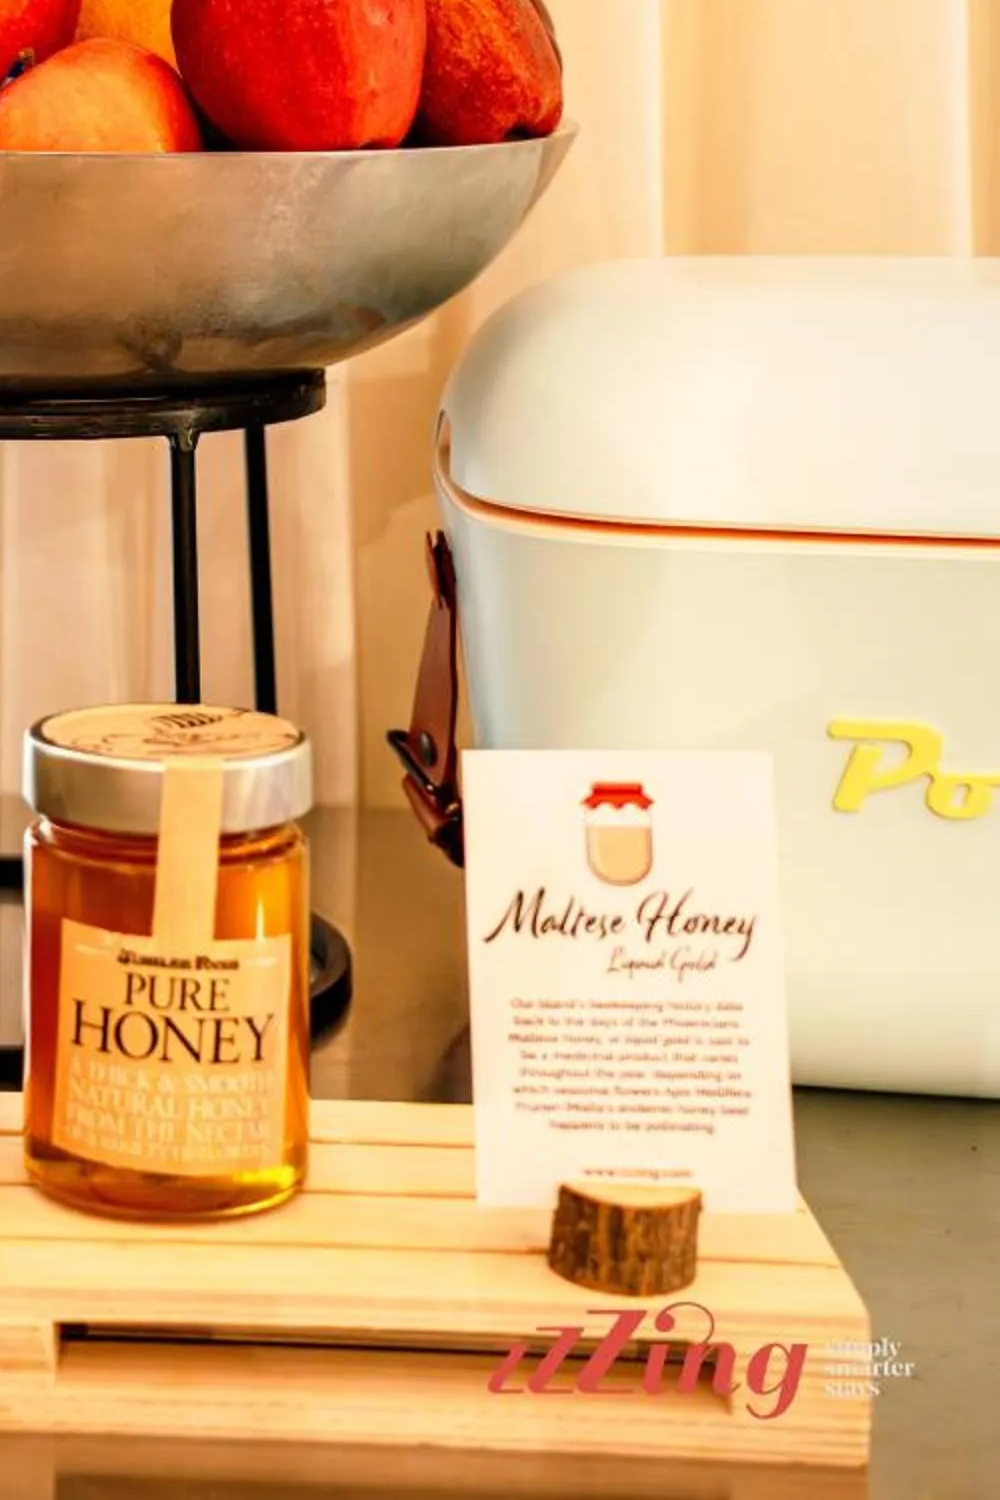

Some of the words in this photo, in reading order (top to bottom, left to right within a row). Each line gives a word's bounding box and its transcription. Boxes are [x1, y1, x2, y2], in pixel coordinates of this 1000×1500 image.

[483, 886, 625, 944] Maltese
[636, 886, 758, 962] Honey
[606, 946, 665, 979] Liquid
[669, 947, 718, 983] Gold
[124, 971, 231, 1012] PURE
[71, 998, 275, 1064] HONEY
